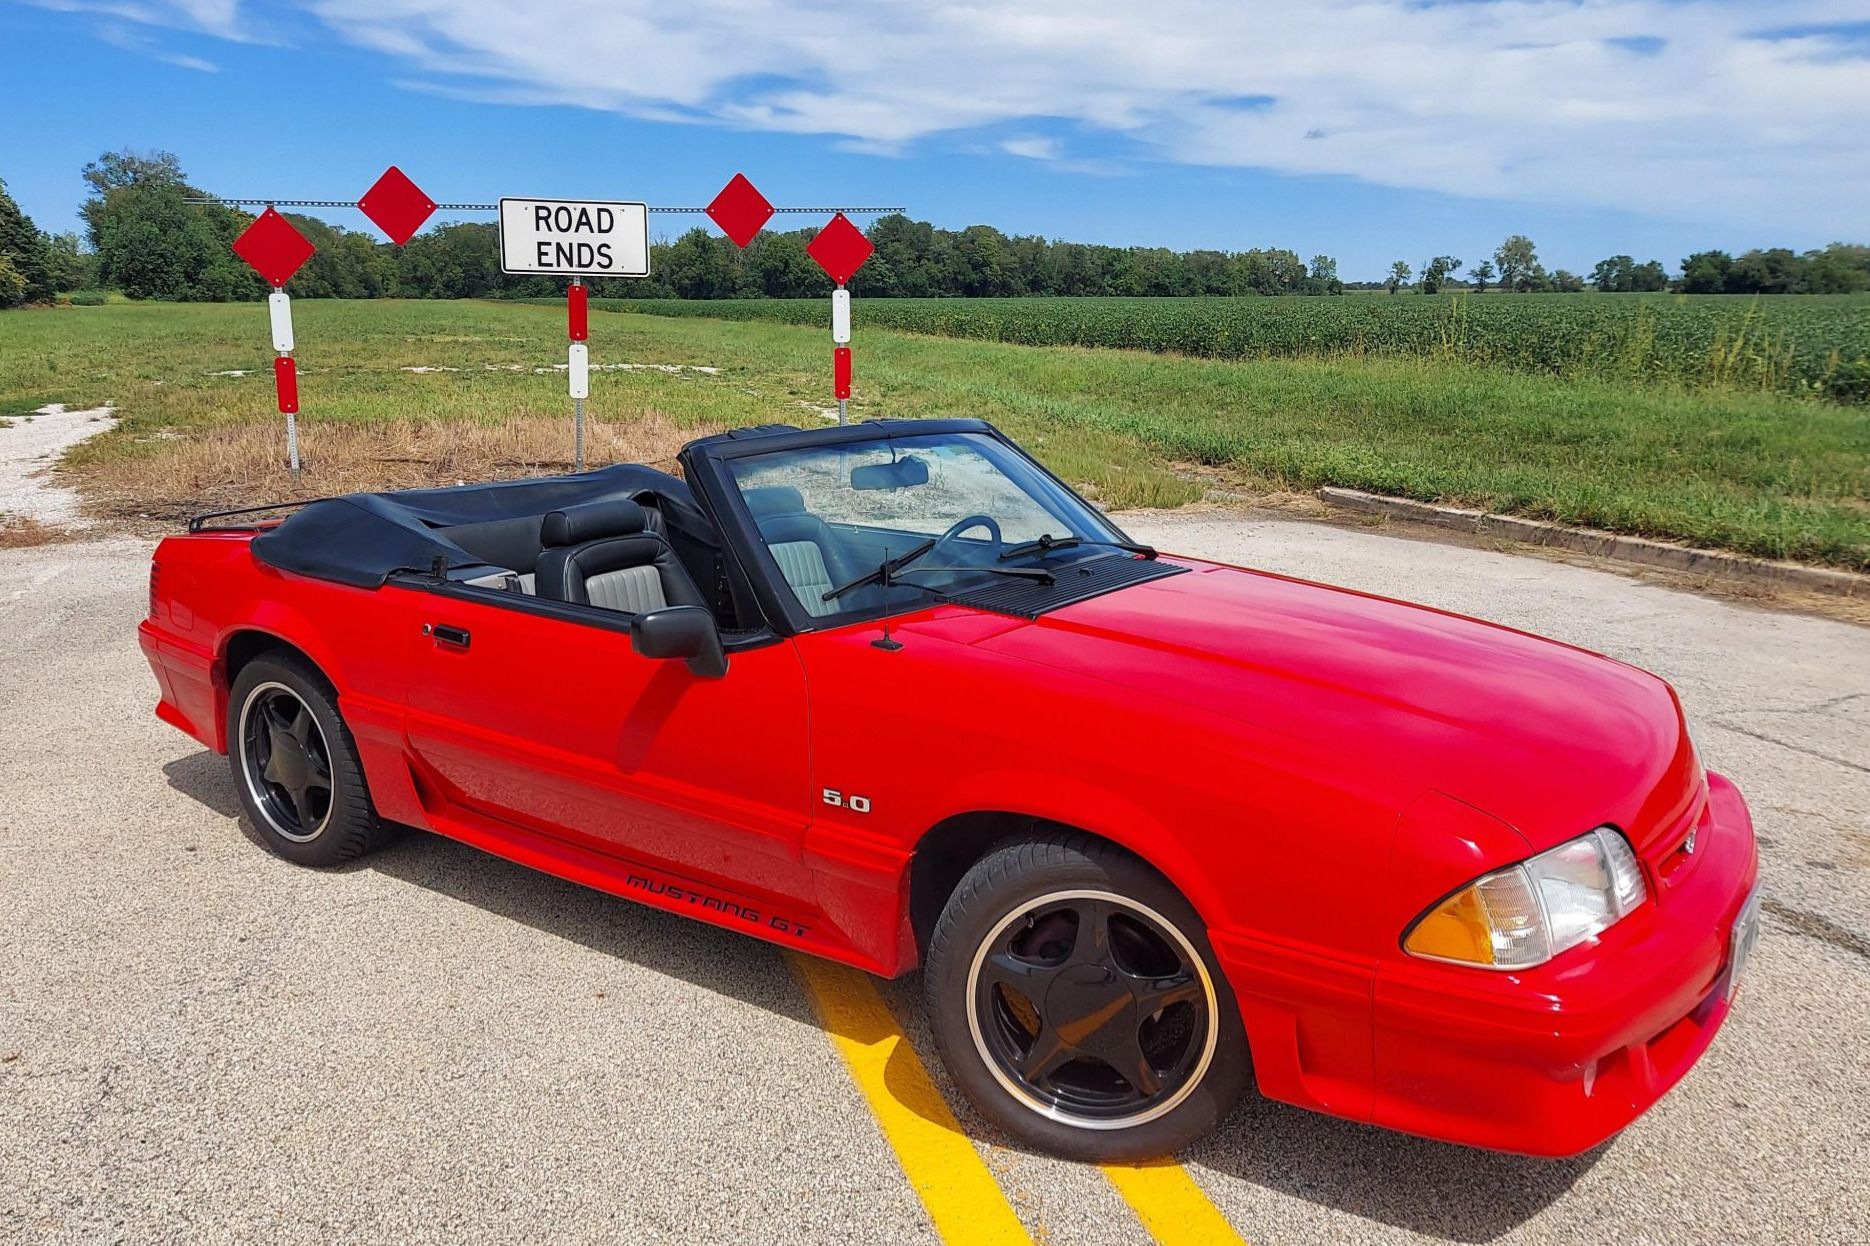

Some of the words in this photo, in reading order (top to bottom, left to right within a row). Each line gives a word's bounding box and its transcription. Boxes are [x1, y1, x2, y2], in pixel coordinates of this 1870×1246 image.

[535, 206, 614, 233] ROAD
[537, 242, 613, 269] ENDS
[822, 788, 871, 813] 5.0
[626, 874, 761, 922] MUSTANG
[768, 915, 812, 936] GT
